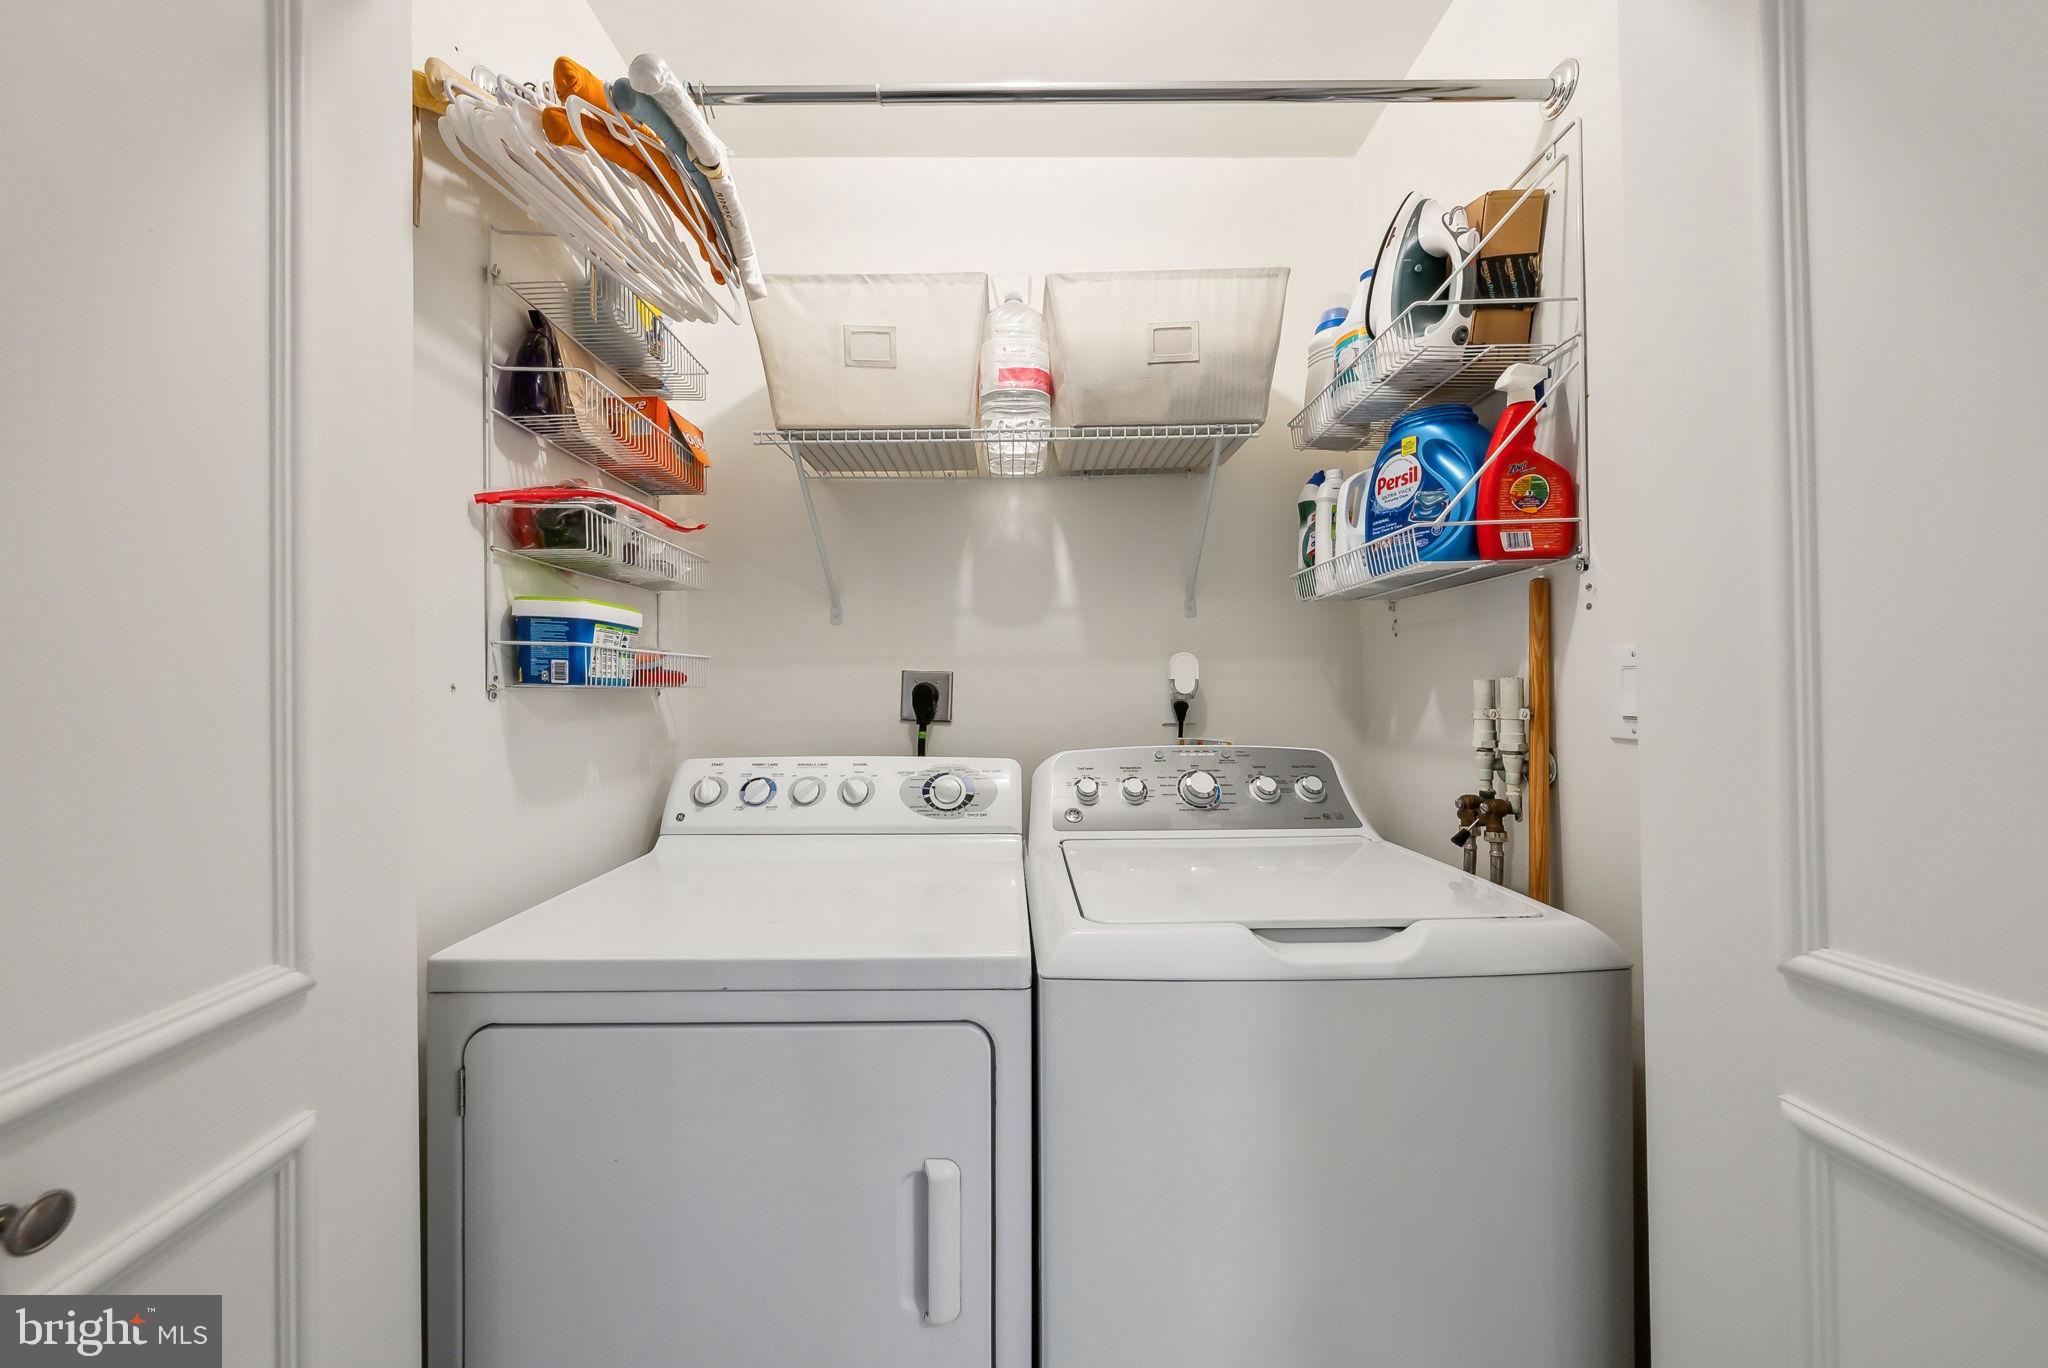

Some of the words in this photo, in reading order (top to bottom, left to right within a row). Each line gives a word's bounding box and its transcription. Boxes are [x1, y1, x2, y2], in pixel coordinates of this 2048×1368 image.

[1481, 261, 1492, 285] amazon
[1506, 257, 1515, 282] amazon
[1511, 281, 1519, 298] Prim
[1377, 465, 1418, 496] Persil
[1381, 491, 1397, 500] ULTRA
